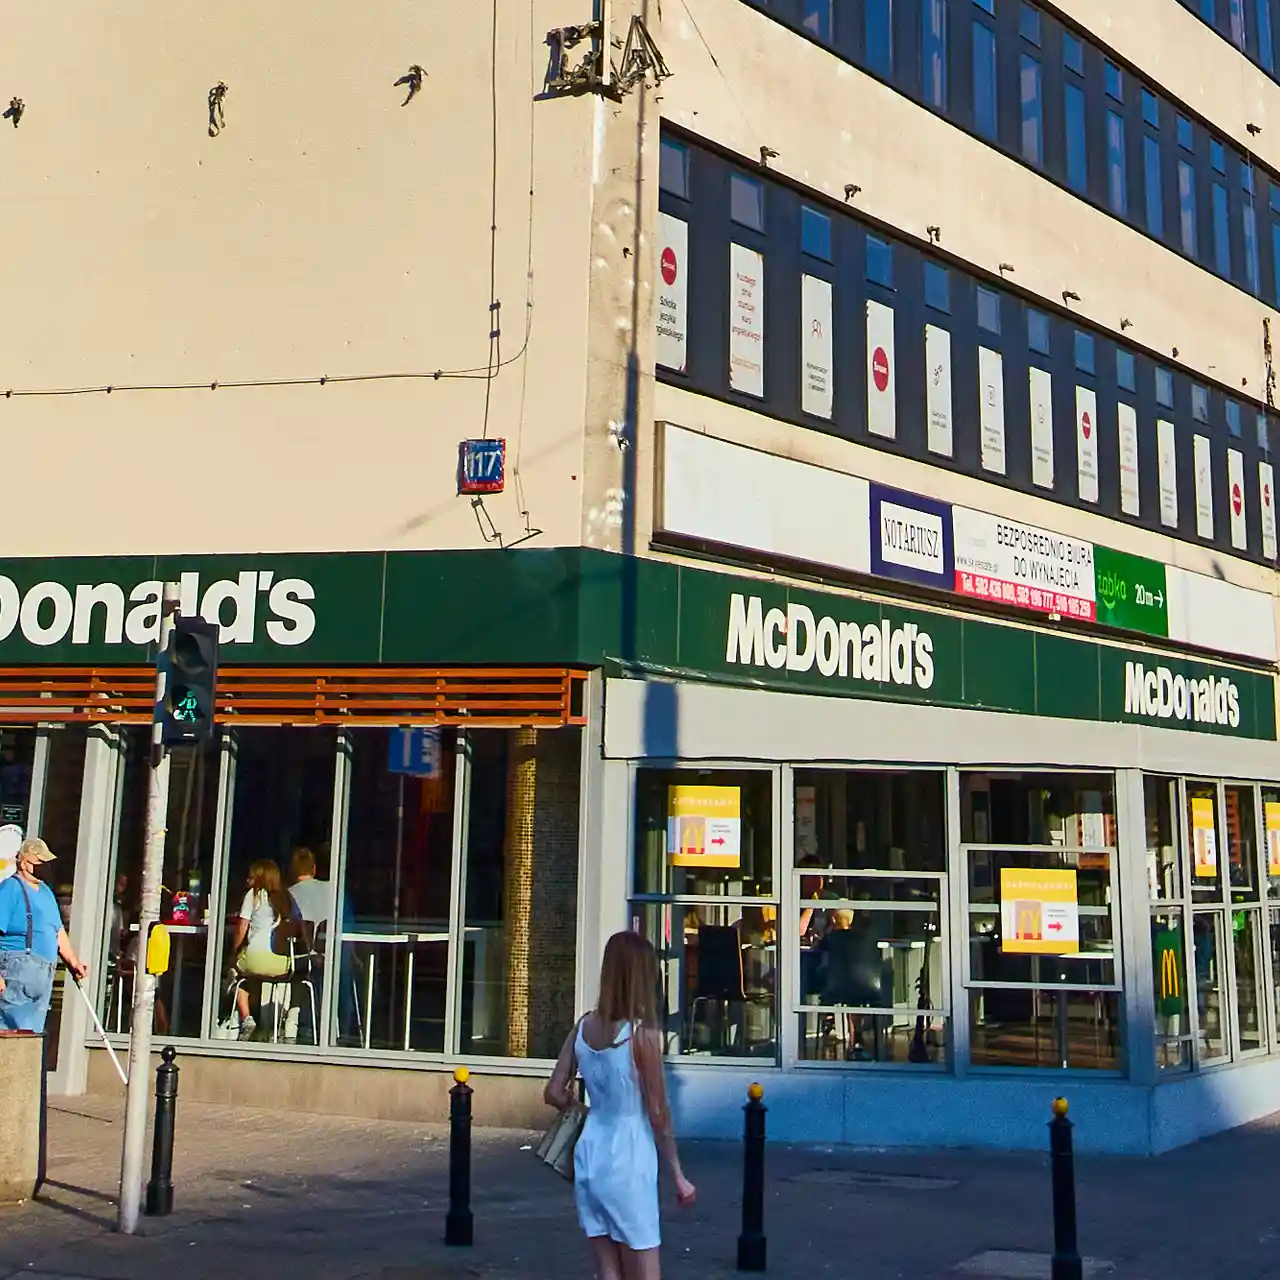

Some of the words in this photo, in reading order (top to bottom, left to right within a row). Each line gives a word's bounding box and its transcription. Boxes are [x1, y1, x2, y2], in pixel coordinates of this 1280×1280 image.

[467, 451, 498, 477] 117
[884, 516, 939, 559] NOTARIUSZ
[1013, 555, 1027, 578] DO
[1097, 569, 1127, 601] żabka
[725, 592, 935, 690] McDonald's
[1124, 660, 1240, 729] McDonald's
